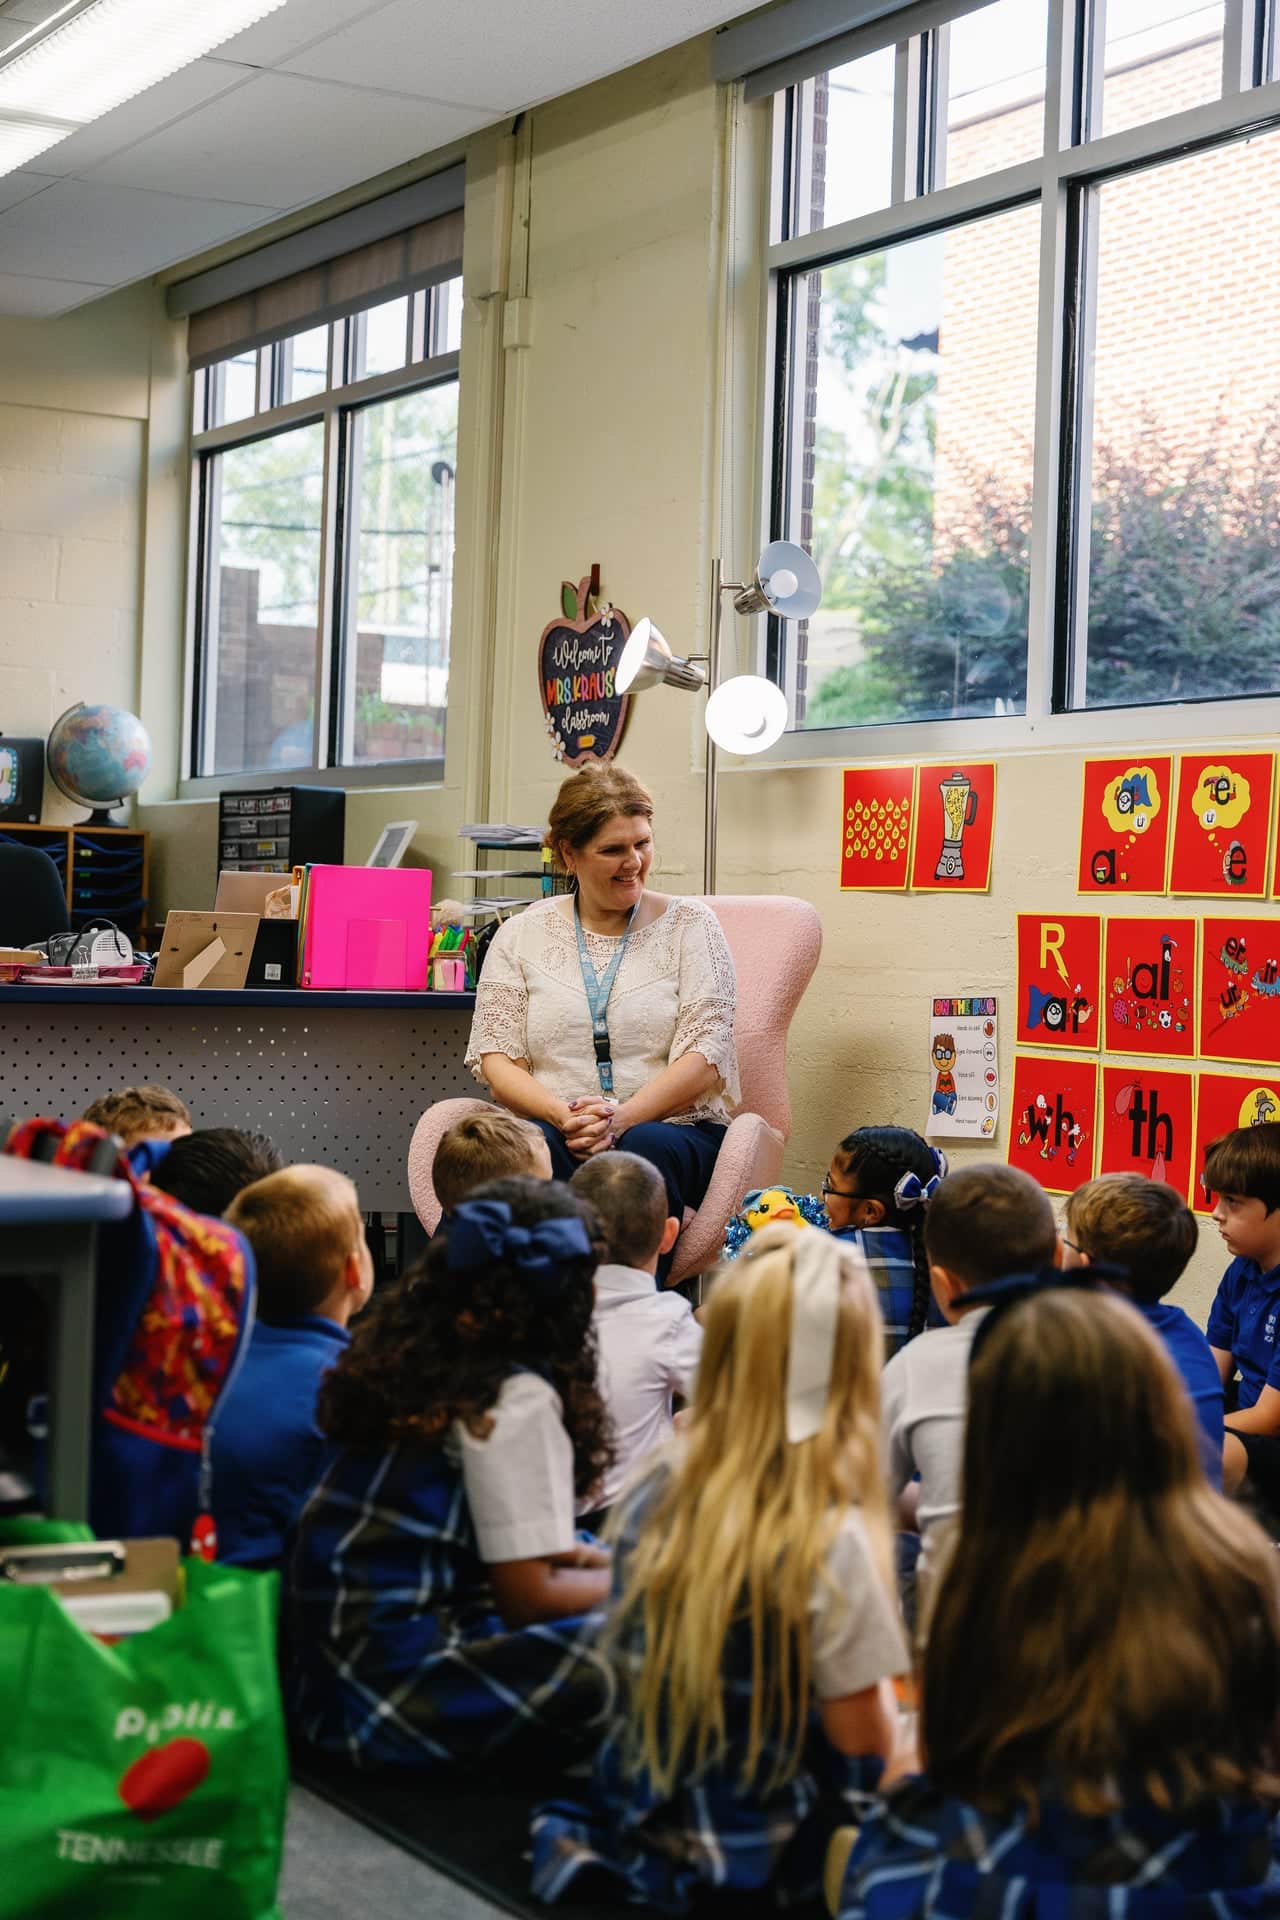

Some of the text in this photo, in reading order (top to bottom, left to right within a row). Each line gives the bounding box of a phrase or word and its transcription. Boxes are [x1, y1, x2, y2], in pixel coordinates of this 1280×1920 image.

[561, 706, 610, 735] classroom
[1091, 848, 1117, 885] a
[1229, 845, 1248, 881] e
[1131, 942, 1172, 1001] al
[952, 999, 970, 1015] THE
[1028, 1093, 1076, 1148] wh
[1129, 1089, 1173, 1161] th
